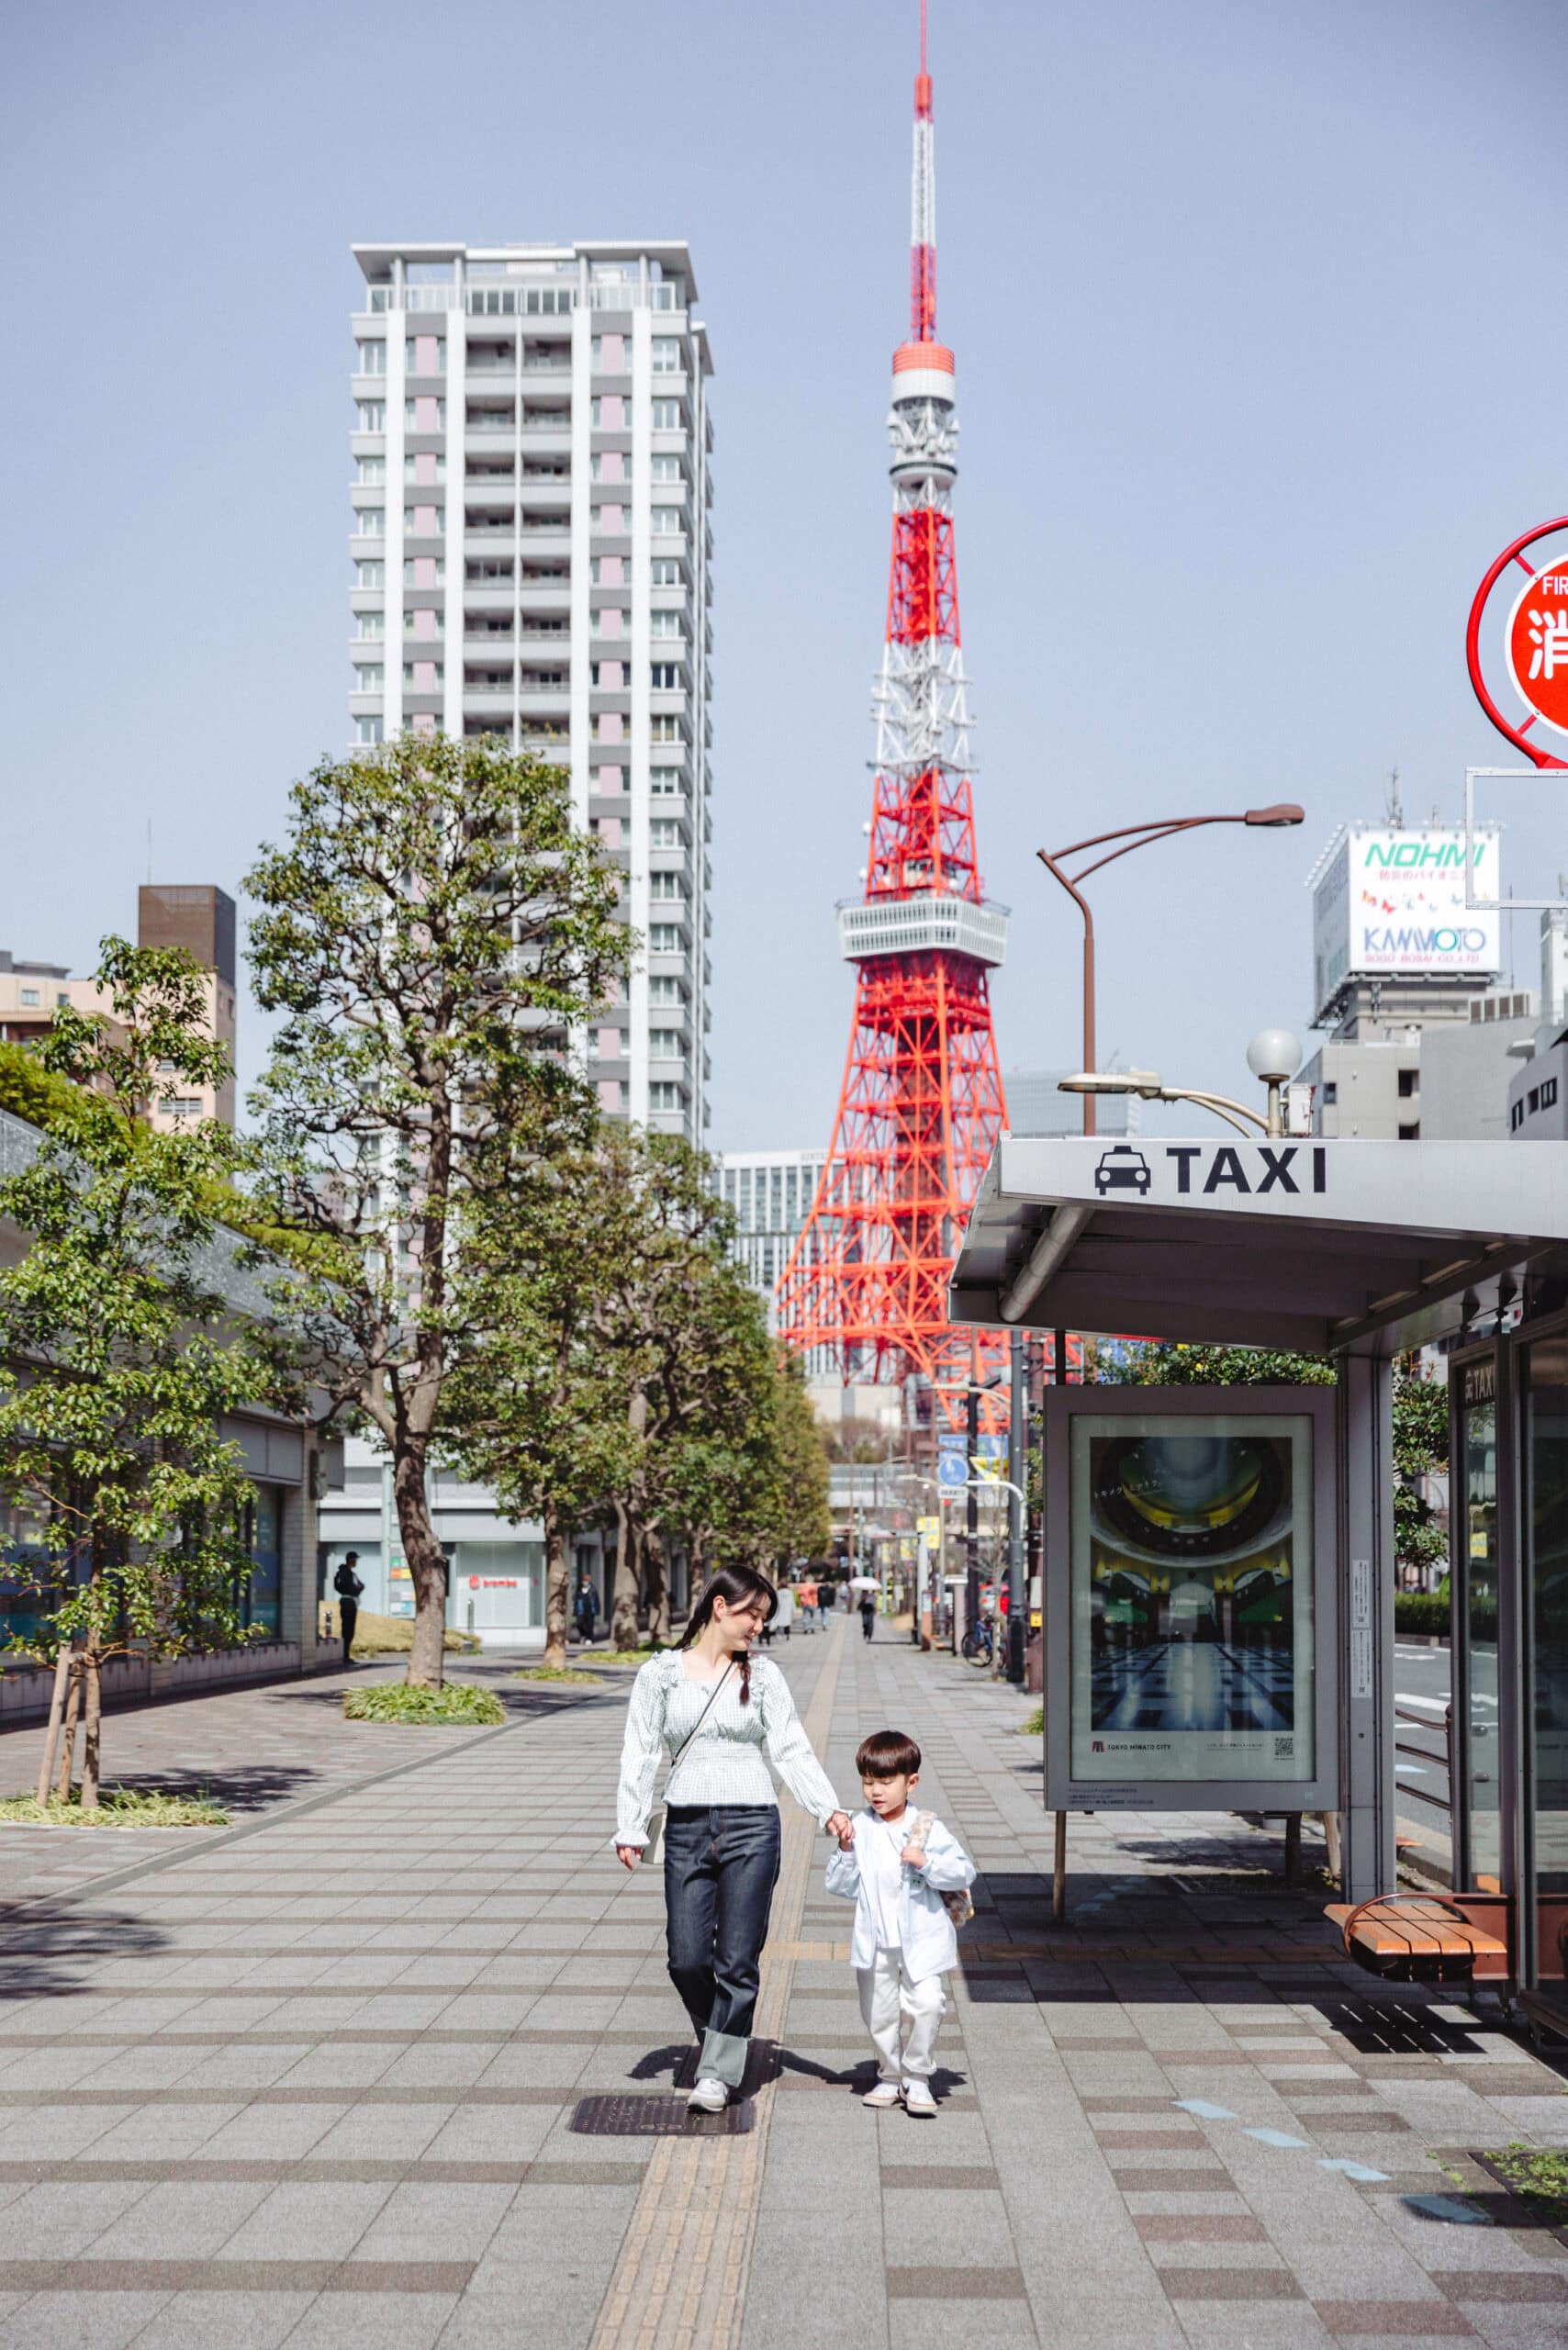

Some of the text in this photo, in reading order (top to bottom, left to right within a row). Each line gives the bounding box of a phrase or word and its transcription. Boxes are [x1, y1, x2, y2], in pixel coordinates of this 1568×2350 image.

[1364, 843, 1486, 867] NOHMI
[1166, 1147, 1326, 1193] TAXI
[1473, 1366, 1495, 1400] TAXI
